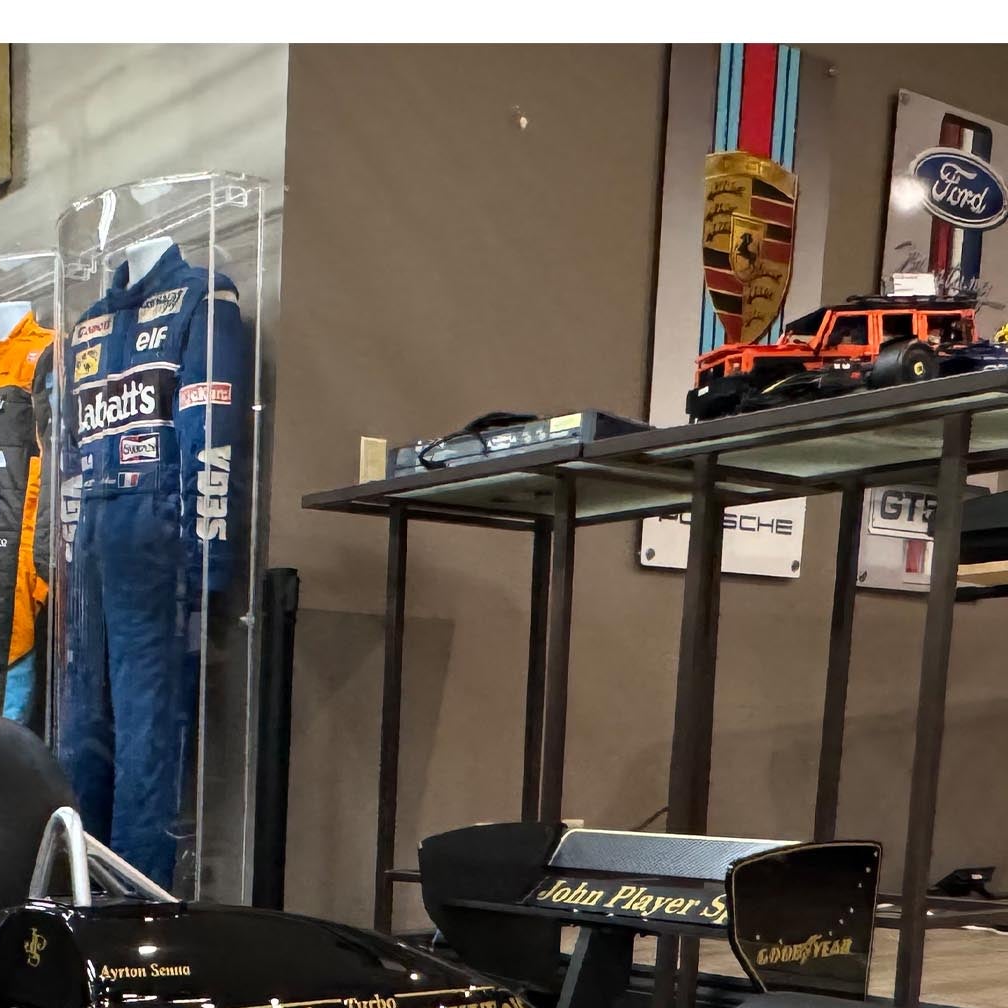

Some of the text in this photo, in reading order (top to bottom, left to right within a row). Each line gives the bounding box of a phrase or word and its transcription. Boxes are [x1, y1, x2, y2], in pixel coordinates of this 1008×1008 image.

[932, 163, 990, 214] Ford
[135, 326, 168, 351] elf
[196, 445, 231, 541] SEGA
[537, 880, 605, 907] John
[607, 886, 701, 917] Player
[99, 963, 191, 981] Ayrton Senna
